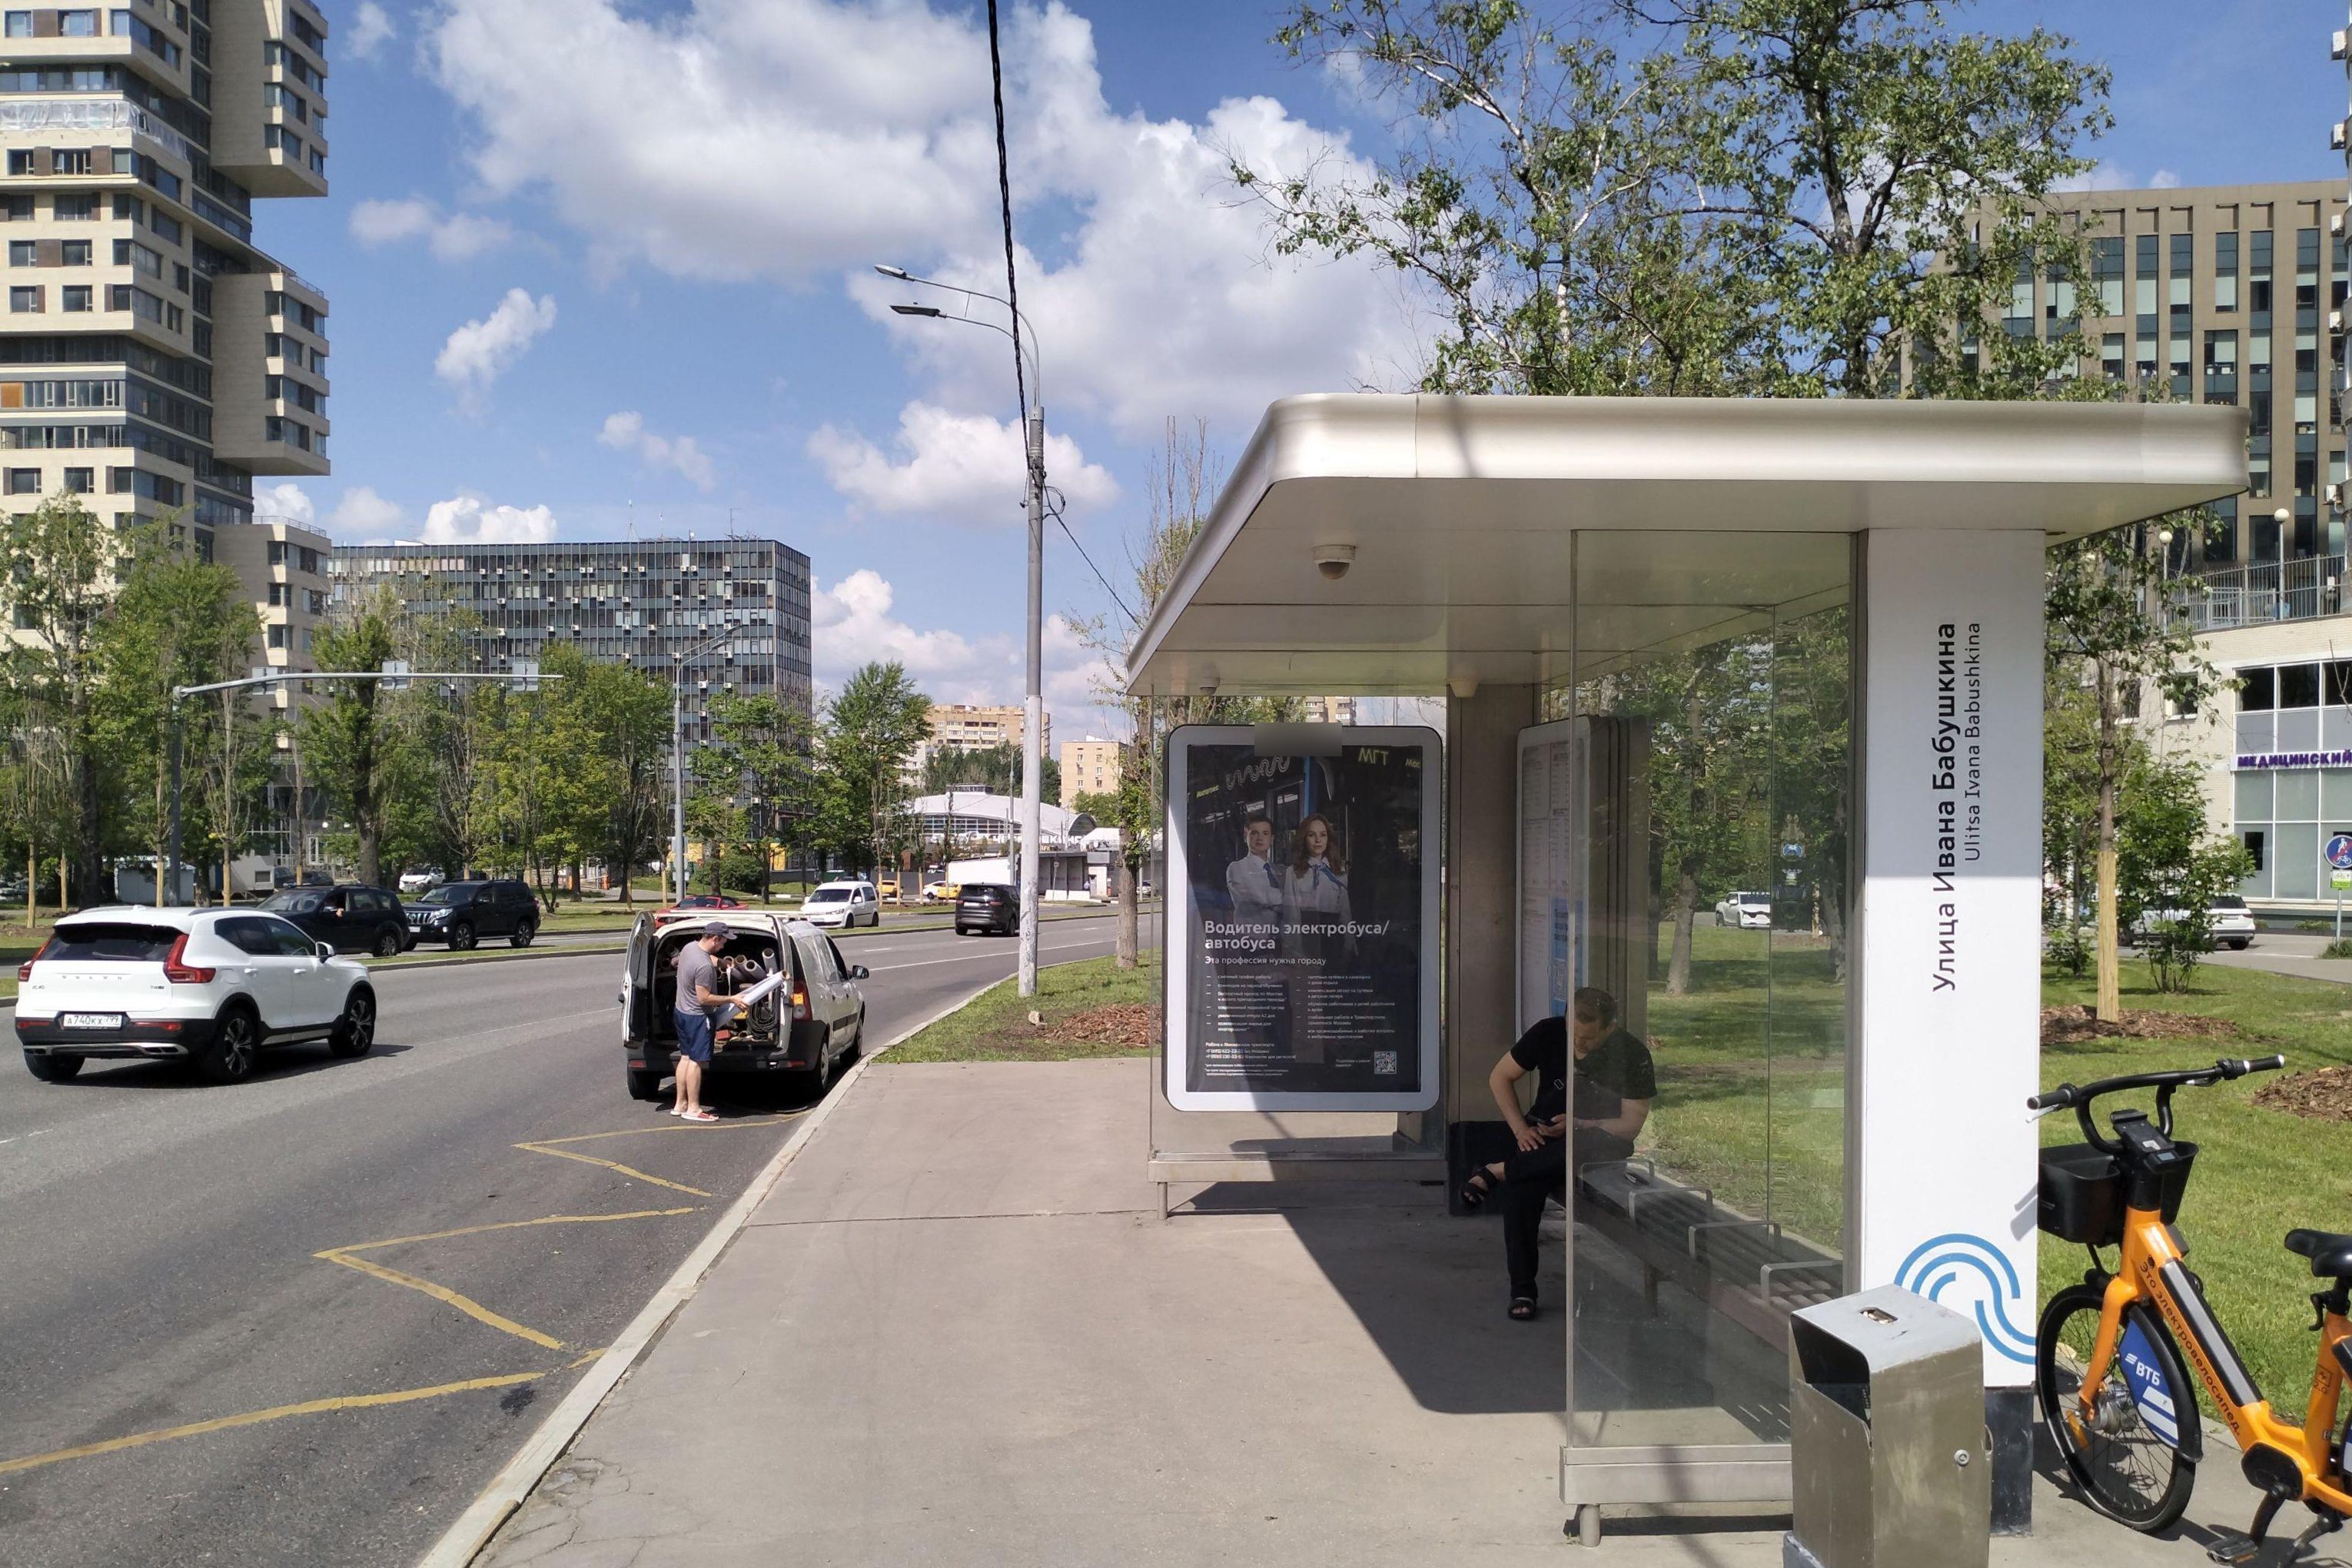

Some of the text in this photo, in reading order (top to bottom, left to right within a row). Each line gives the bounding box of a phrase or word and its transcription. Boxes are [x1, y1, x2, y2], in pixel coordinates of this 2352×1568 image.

[1965, 623, 1981, 862] Ulitsa Ivana Babushkina
[2237, 749, 2352, 768] МЕДИЦИНСКИЙ
[1932, 623, 1961, 992] Улица Ивана Бабушкина
[1204, 920, 1390, 937] Водитель электробуса/
[1204, 935, 1276, 952] автобуса
[1204, 955, 1327, 966] Эта профессия нужна городу
[2140, 1261, 2240, 1436] Это электровелосипед.
[2135, 1362, 2161, 1387] ВТБ
